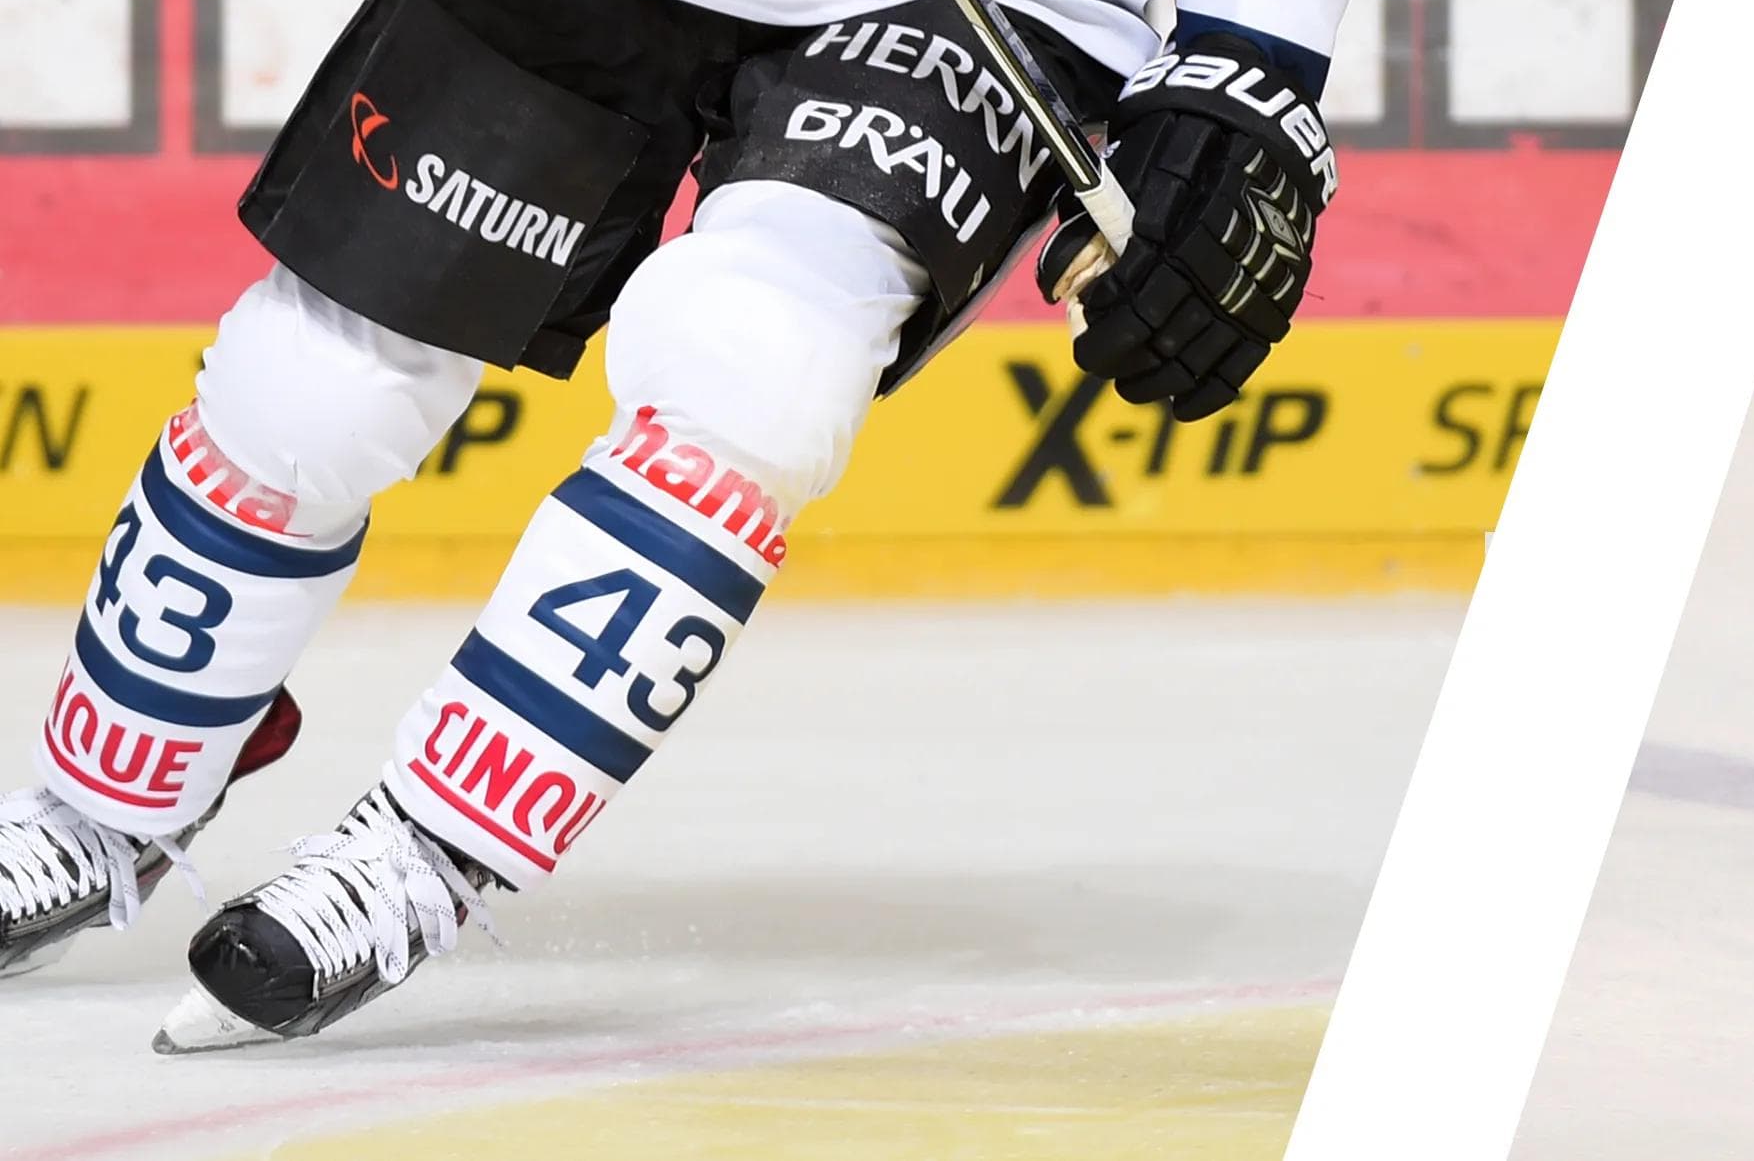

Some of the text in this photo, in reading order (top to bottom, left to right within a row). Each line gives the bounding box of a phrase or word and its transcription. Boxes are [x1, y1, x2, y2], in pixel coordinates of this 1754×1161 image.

[784, 99, 992, 244] BRÄU
[804, 22, 1051, 194] HERRN
[405, 152, 586, 267] SATURN
[94, 500, 233, 675] 43
[527, 567, 727, 733] 43
